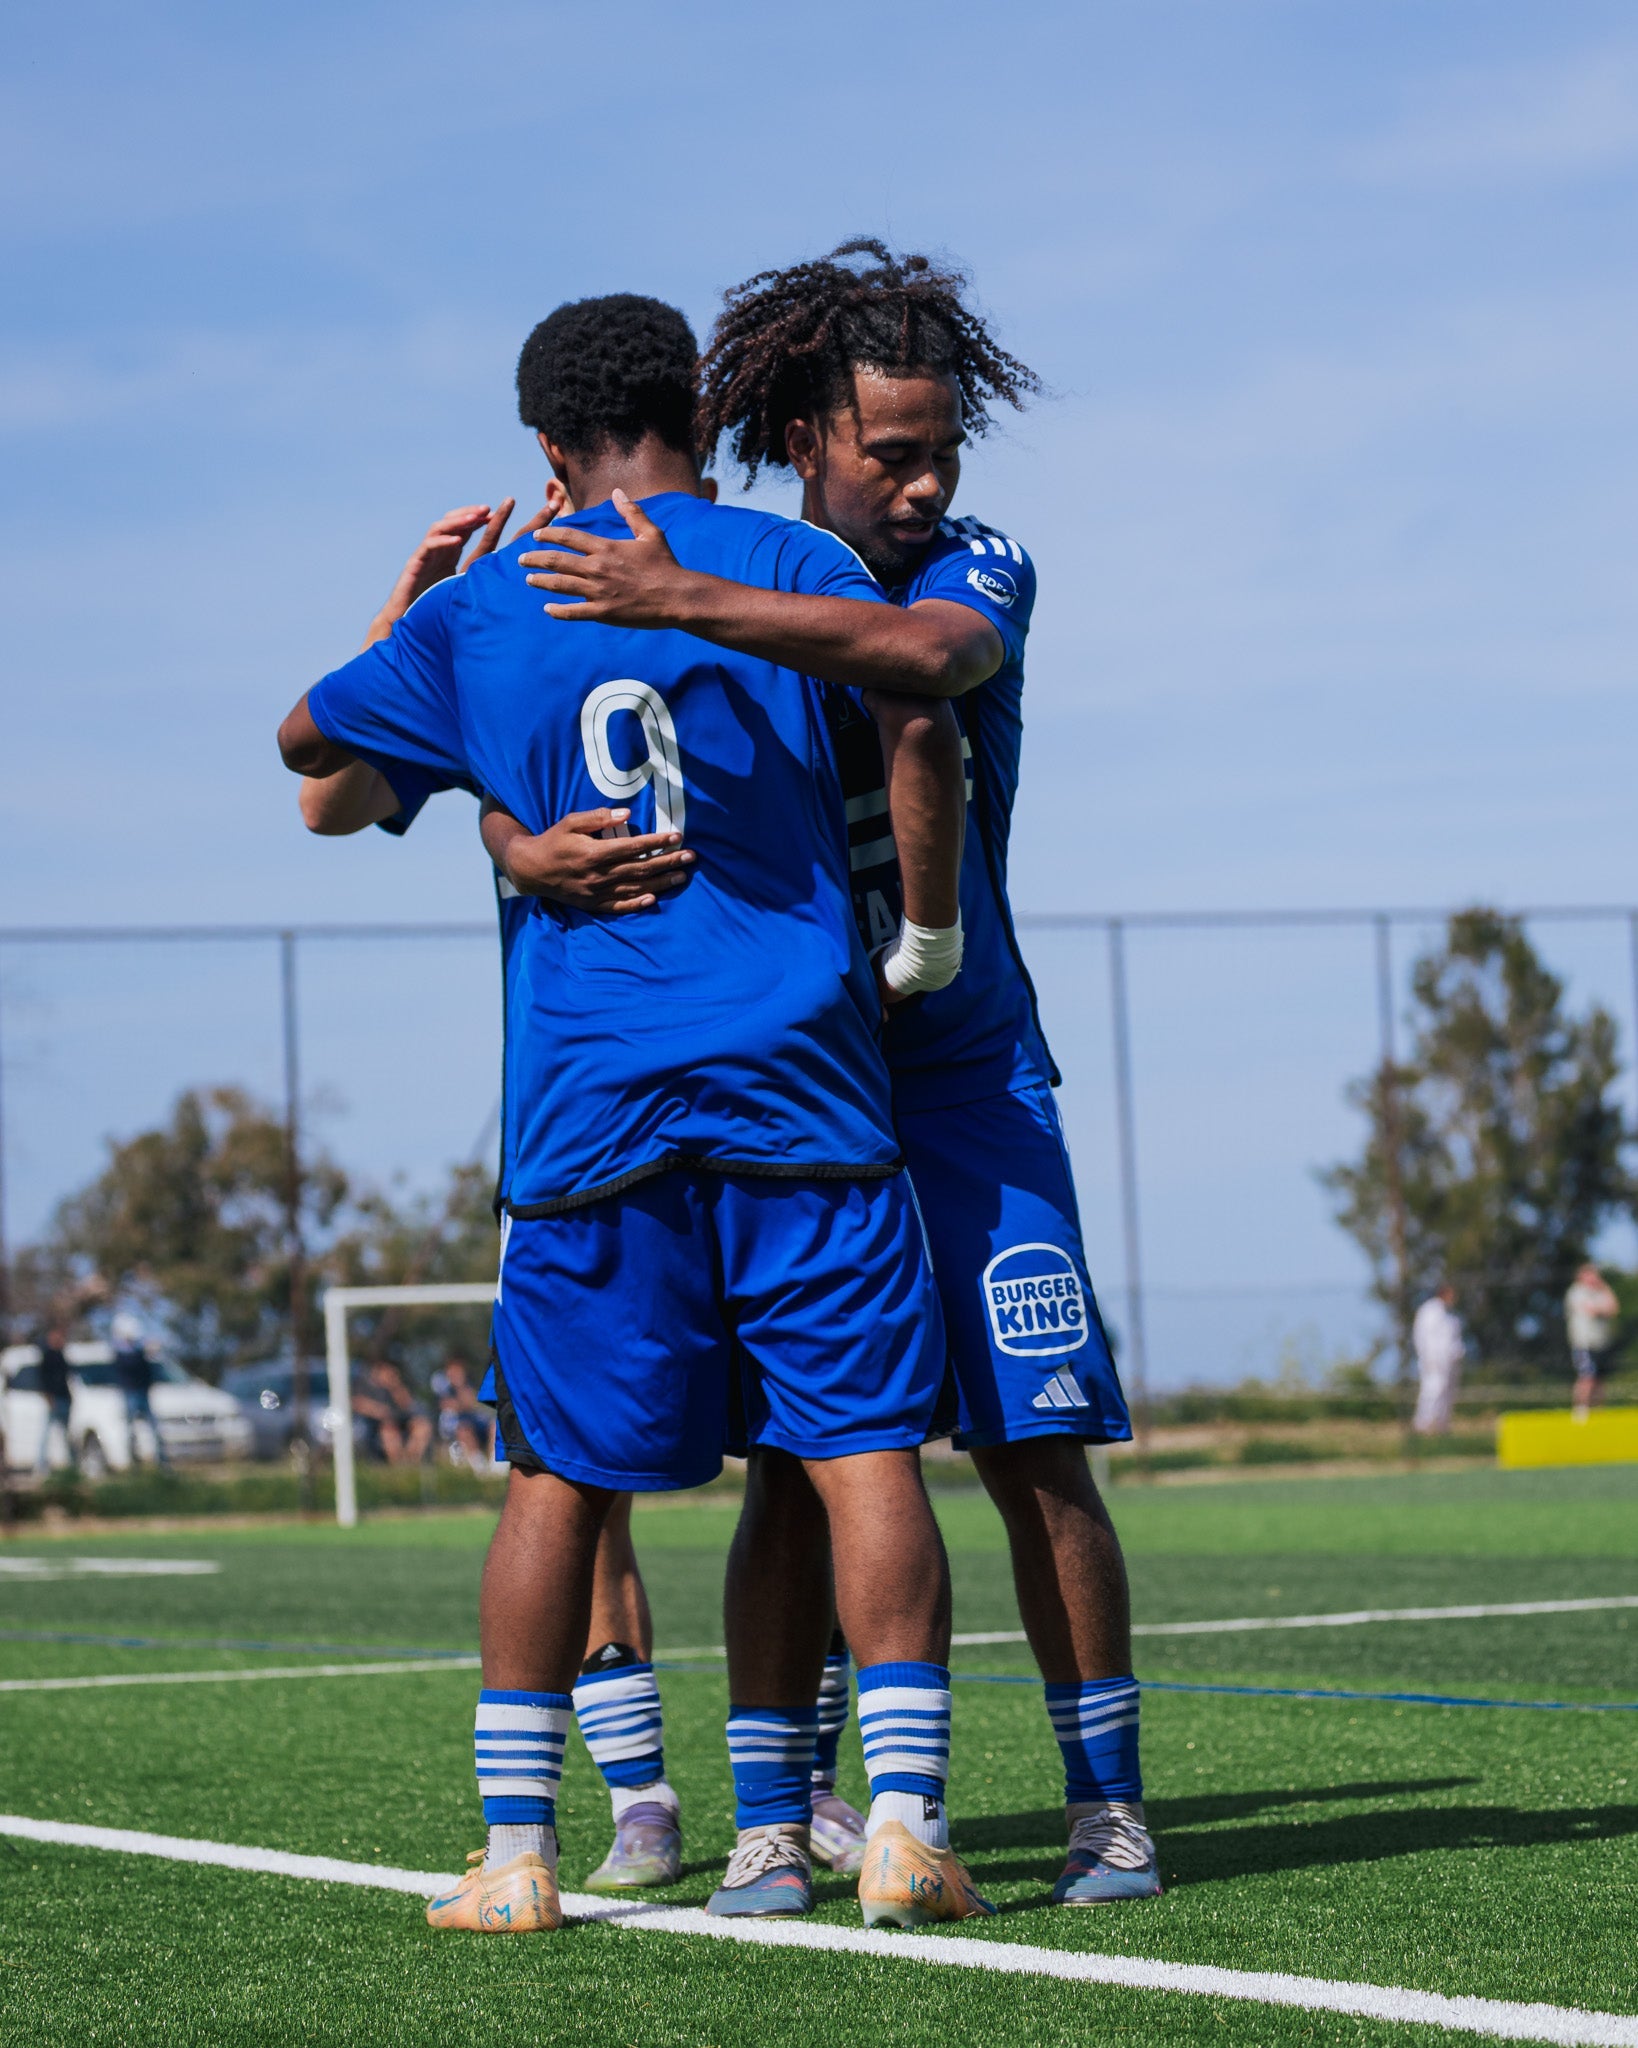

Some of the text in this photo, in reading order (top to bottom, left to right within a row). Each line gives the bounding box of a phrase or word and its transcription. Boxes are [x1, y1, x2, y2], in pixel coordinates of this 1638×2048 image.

[580, 679, 686, 856] 9
[991, 1276, 1079, 1305] BURGER
[996, 1298, 1081, 1334] KING
